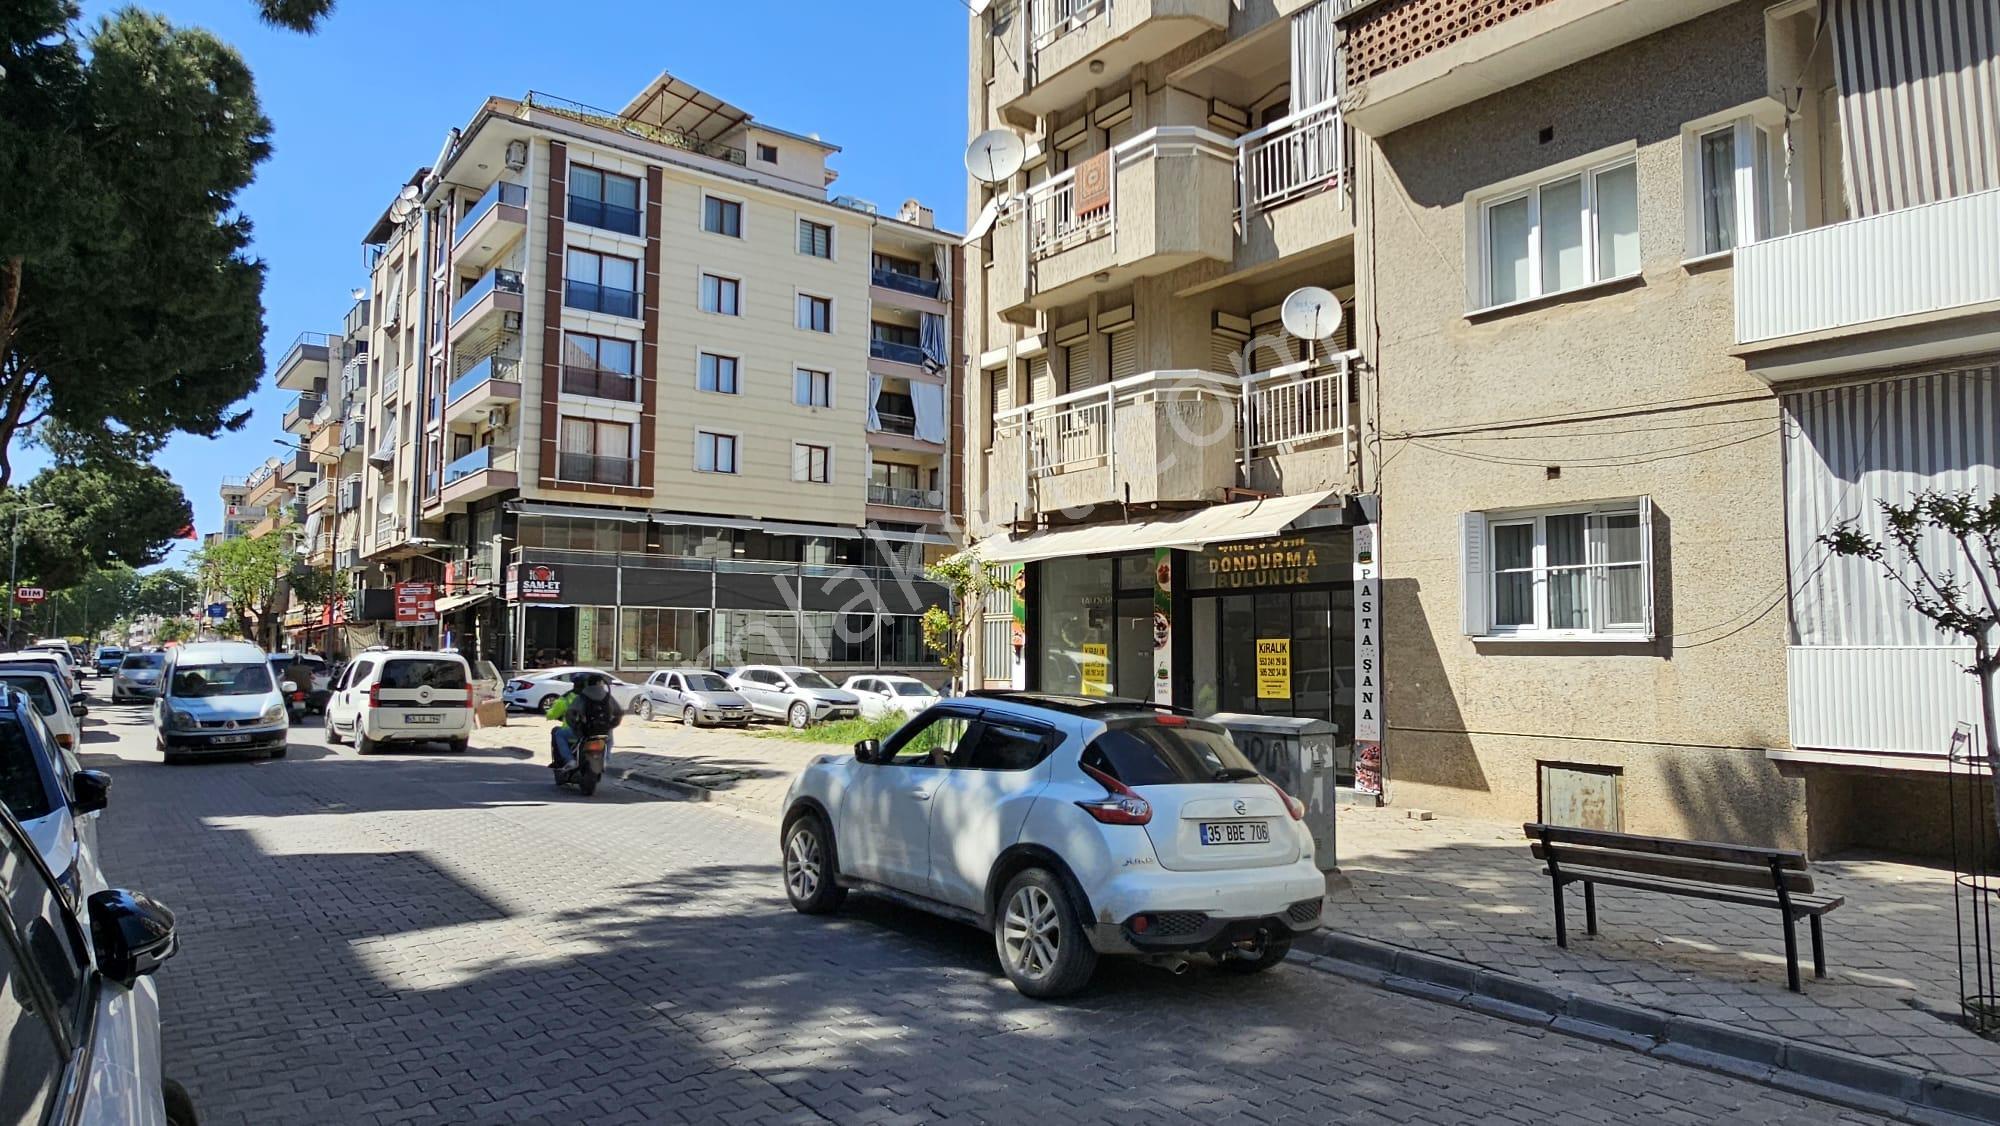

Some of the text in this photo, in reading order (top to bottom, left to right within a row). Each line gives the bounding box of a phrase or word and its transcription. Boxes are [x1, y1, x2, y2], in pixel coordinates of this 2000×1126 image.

[1209, 549, 1318, 573] DONDURMA
[522, 580, 561, 590] SAM-ET
[1217, 567, 1310, 588] BULUNUR
[1361, 568, 1374, 720] PASTA ŞANA
[1208, 824, 1269, 842] 35 BBE 706
